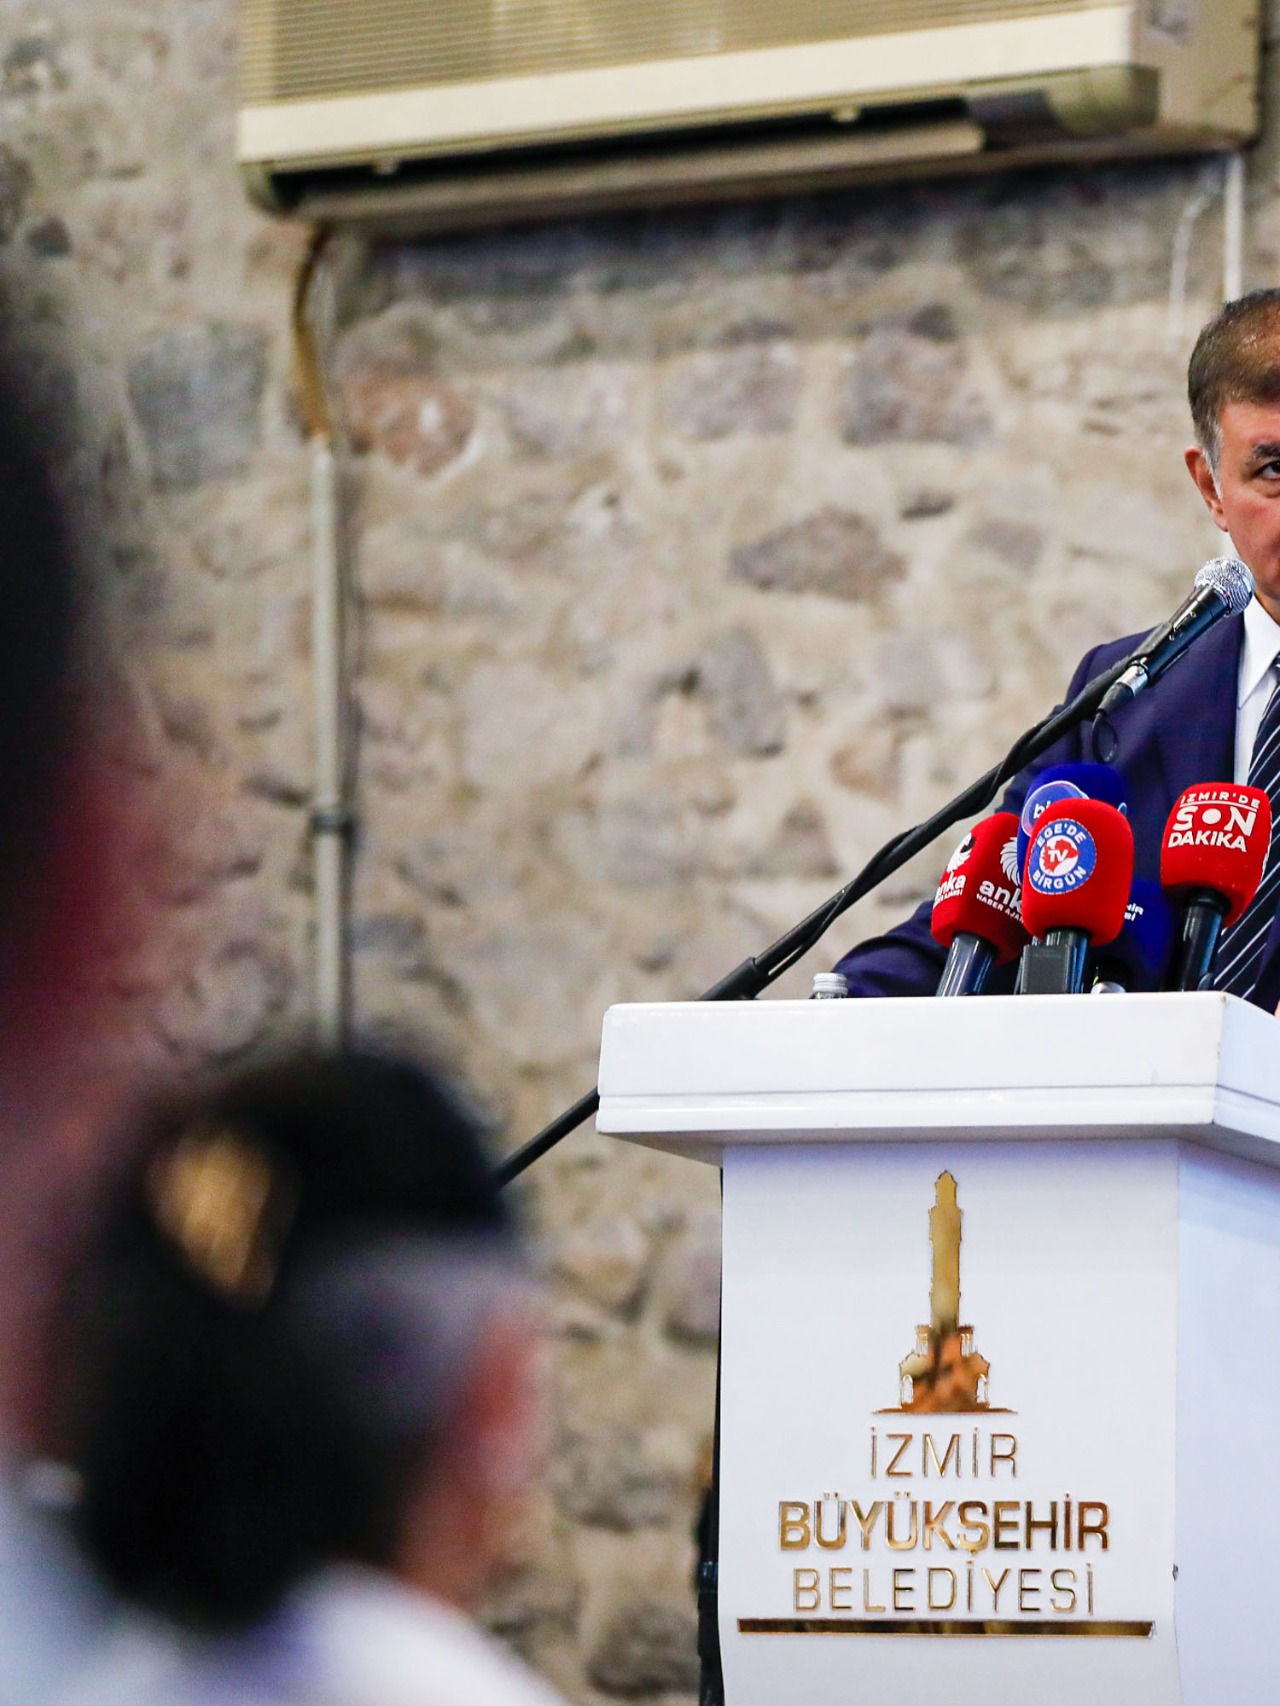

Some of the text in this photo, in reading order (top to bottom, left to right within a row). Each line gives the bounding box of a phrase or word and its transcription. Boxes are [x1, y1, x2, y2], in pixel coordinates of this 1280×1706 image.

[1036, 823, 1087, 849] EGE'DE
[1048, 850, 1069, 863] TV
[979, 880, 1023, 914] ank
[1004, 907, 1024, 924] AJA
[870, 1427, 1019, 1478] İZMİR
[778, 1491, 1110, 1556] BÜYÜKŞEHİR
[792, 1561, 1094, 1616] BELEDİYESİ
